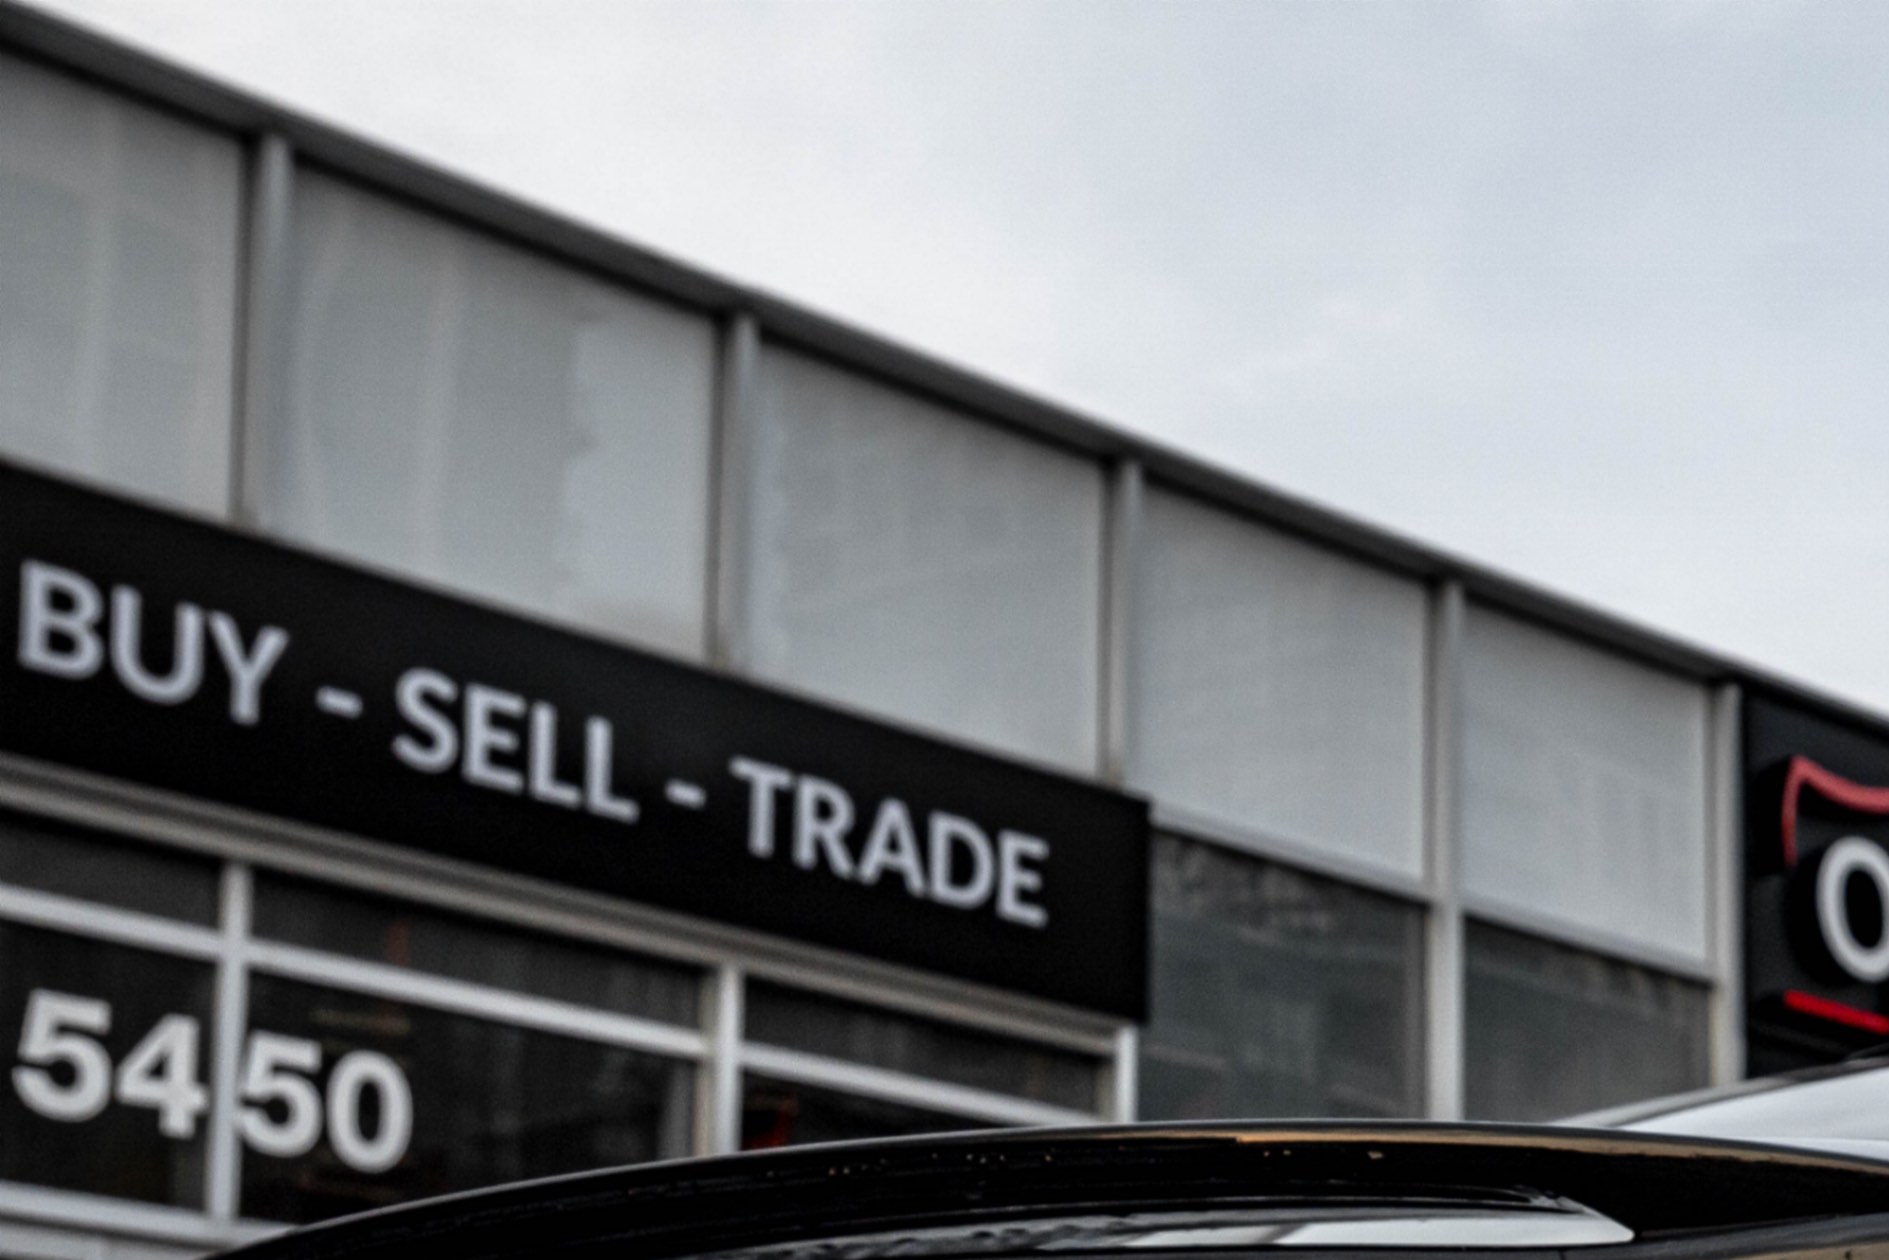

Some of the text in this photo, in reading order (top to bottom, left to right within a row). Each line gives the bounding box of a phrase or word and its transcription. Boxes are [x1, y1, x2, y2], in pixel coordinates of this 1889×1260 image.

[17, 558, 1050, 928] BUY - SELL - TRADE
[11, 988, 413, 1172] 5450
